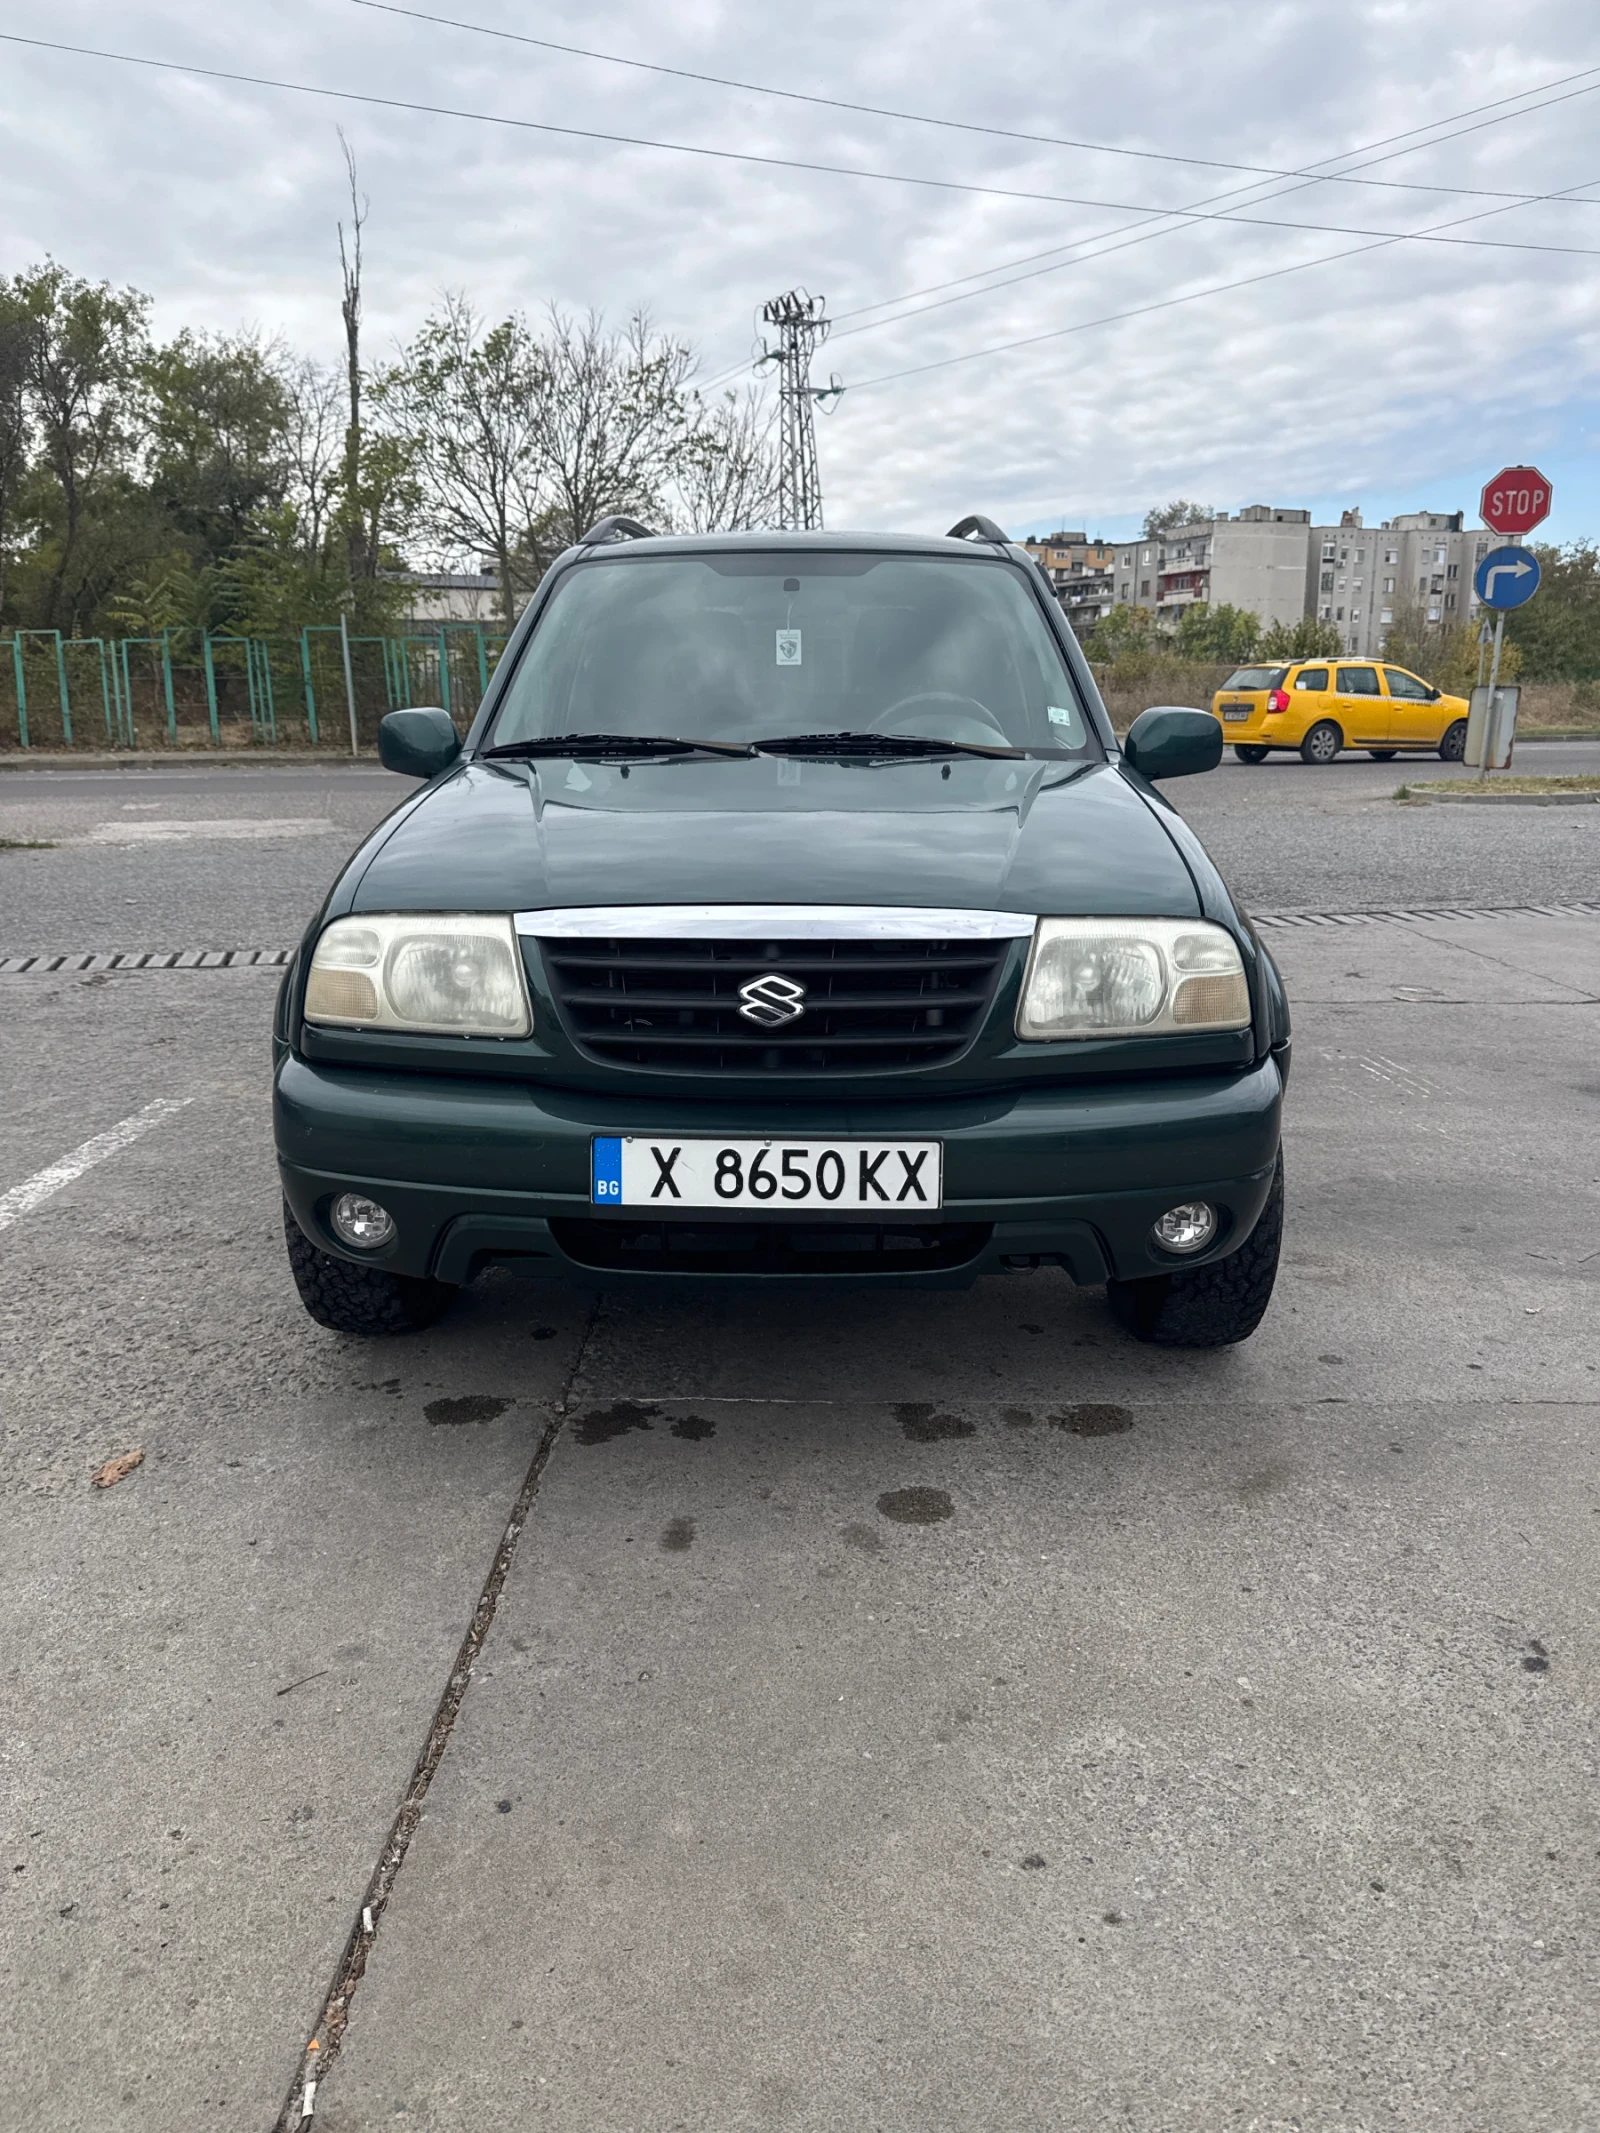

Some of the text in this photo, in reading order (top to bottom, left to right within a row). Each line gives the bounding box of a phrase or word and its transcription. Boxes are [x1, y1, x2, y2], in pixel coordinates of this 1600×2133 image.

[1491, 489, 1545, 516] STOP
[650, 1147, 929, 1202] X 8650 KX
[596, 1180, 620, 1197] BG
